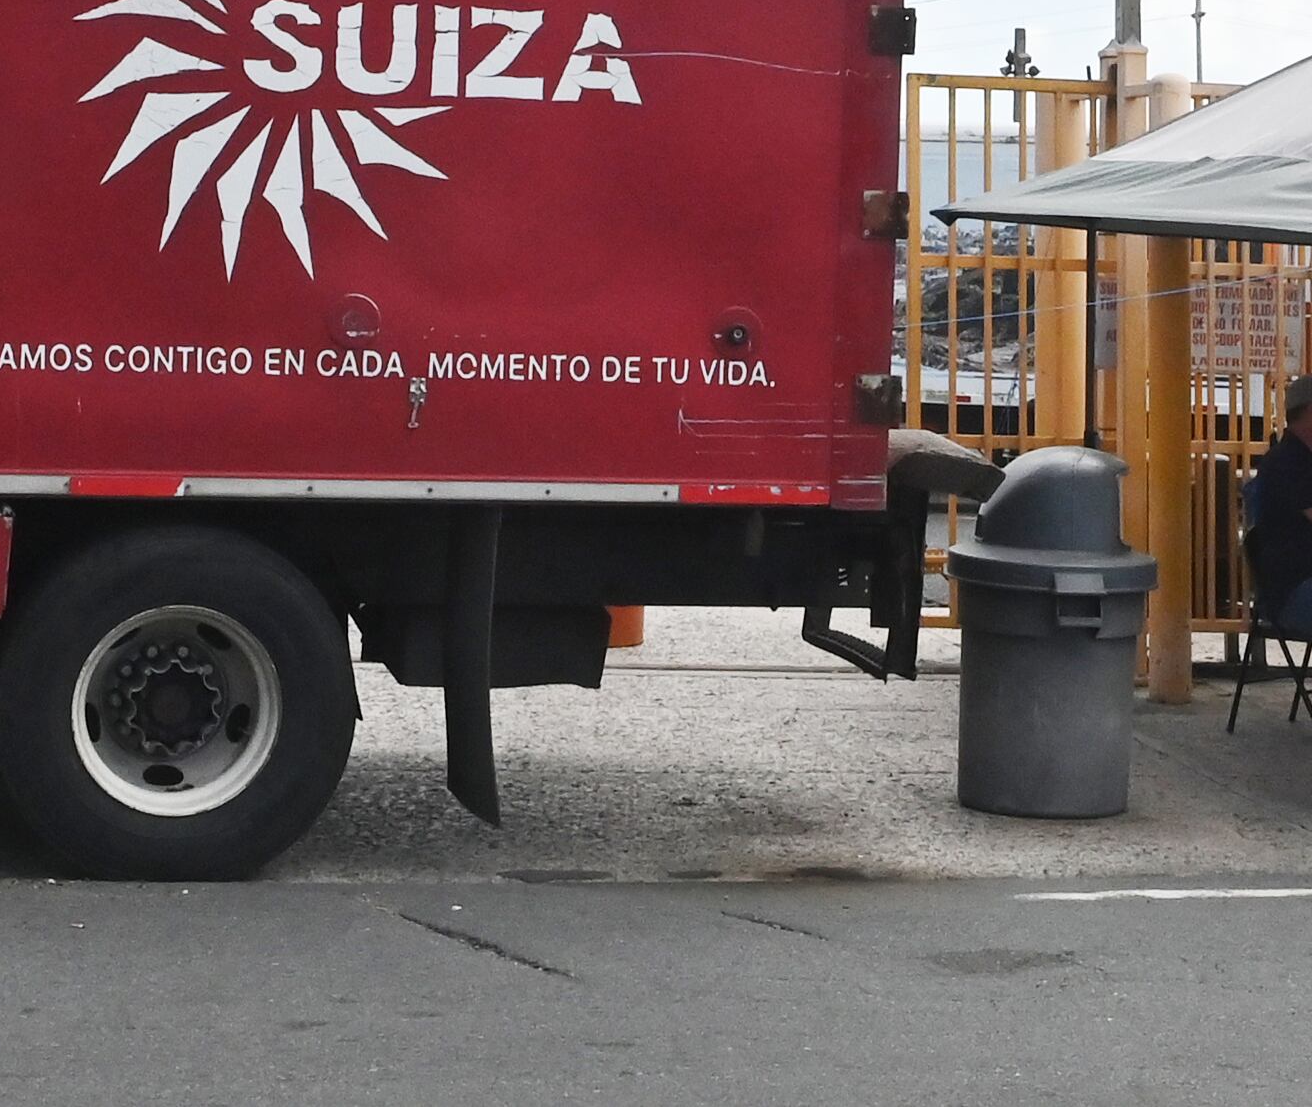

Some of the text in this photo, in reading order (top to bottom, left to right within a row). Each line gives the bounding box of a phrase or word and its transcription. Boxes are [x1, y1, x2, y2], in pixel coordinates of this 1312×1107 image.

[104, 344, 253, 376] CONTIGO
[264, 347, 305, 376] EN
[316, 349, 406, 379] CADA
[428, 352, 590, 383] MOMENTO
[601, 356, 641, 384] DE
[652, 356, 690, 385] TU
[699, 358, 776, 387] VIDA.
